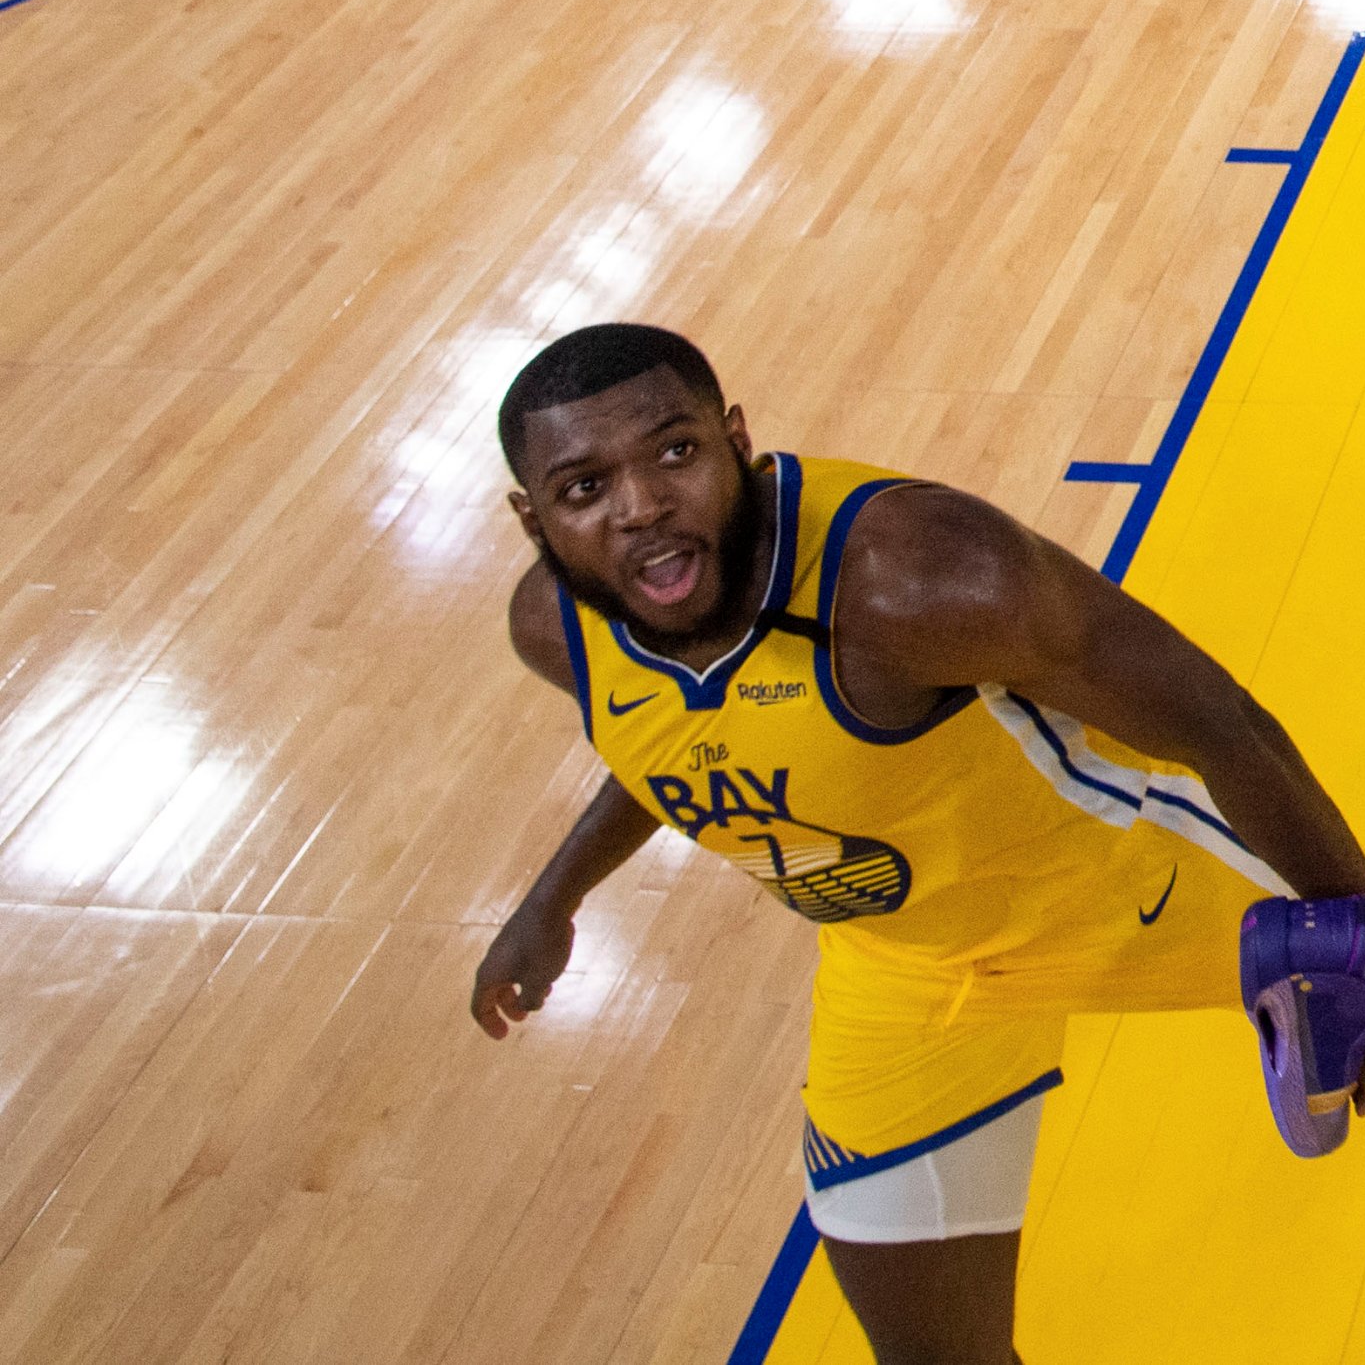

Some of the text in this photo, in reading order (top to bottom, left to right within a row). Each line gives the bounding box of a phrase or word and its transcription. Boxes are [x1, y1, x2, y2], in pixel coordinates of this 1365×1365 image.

[737, 681, 807, 704] Rakuten
[688, 741, 730, 772] The
[646, 767, 790, 841] BAY
[738, 833, 787, 877] 7
